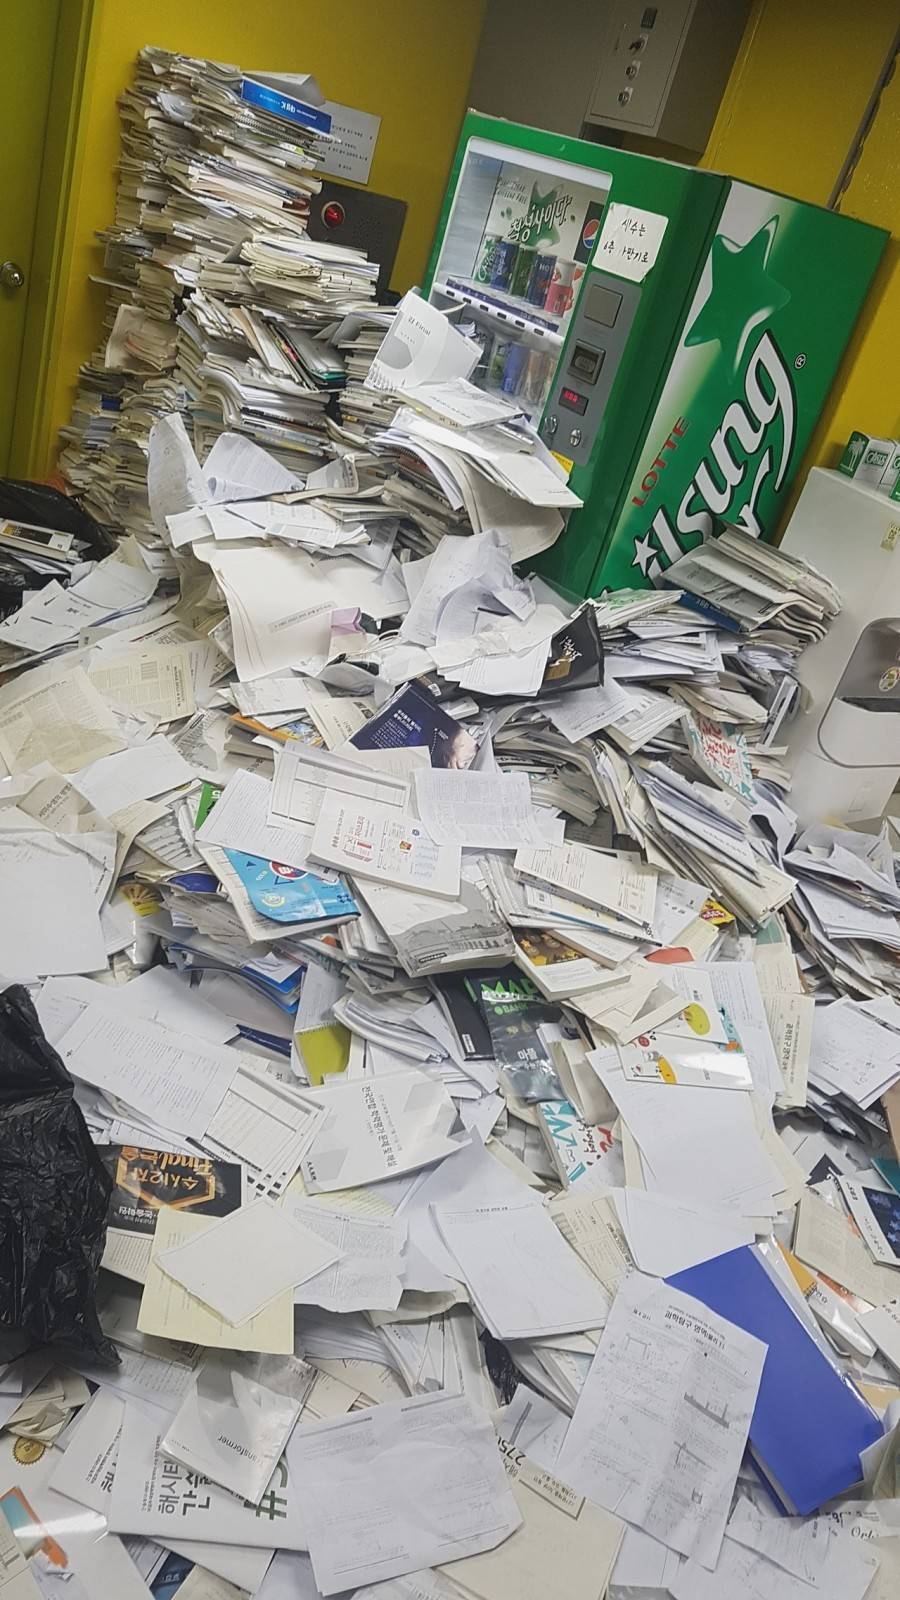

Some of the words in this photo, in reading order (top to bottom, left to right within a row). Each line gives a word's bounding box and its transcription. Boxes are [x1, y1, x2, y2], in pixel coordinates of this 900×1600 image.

[622, 246, 648, 262] 판기로
[632, 416, 690, 507] LOTTE
[134, 1167, 199, 1191] 수시2차
[497, 1433, 525, 1467] 275
